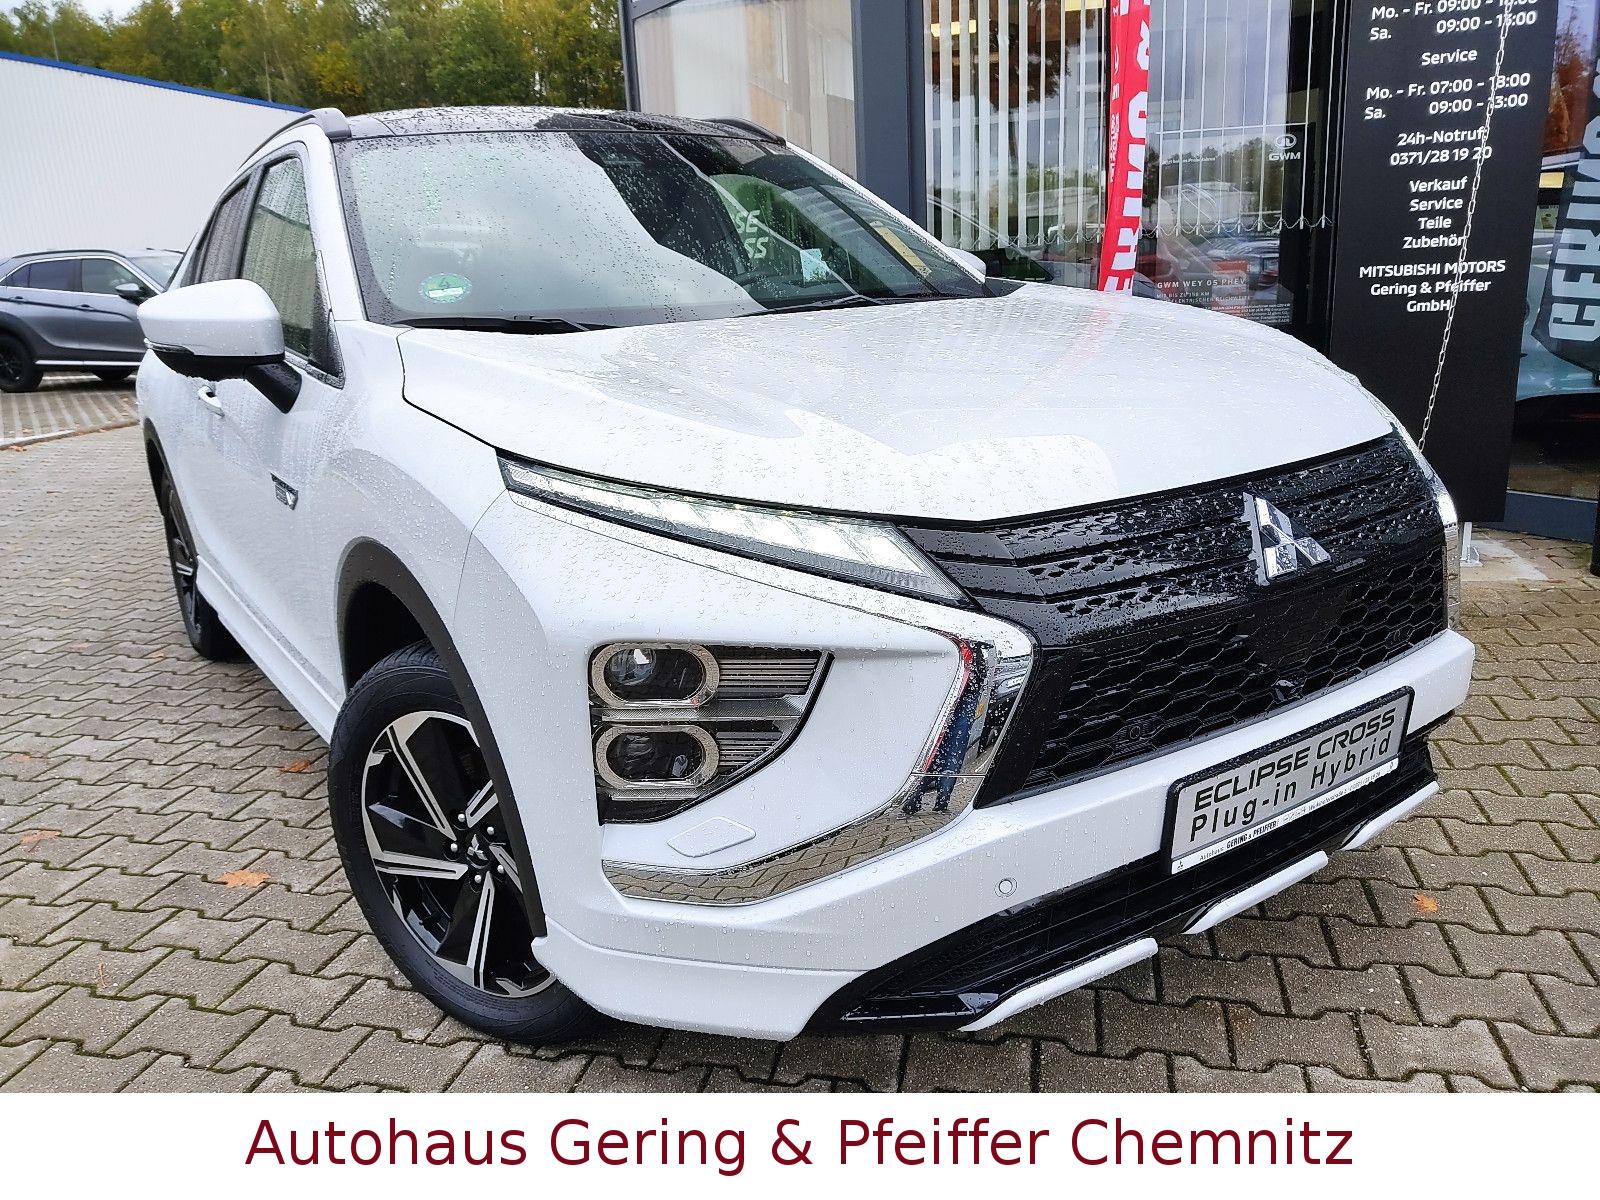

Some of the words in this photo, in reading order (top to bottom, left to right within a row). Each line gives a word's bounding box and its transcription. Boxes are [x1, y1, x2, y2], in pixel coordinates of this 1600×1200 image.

[1371, 6, 1399, 21] Mo.
[1414, 2, 1433, 16] Fr.
[1369, 27, 1392, 41] Sa.
[1435, 16, 1481, 34] 09:00
[1421, 48, 1478, 66] Service
[1365, 86, 1393, 101] Mo.
[1407, 83, 1427, 97] Fr.
[1430, 78, 1473, 95] 07:00
[1363, 106, 1386, 120] Sa.
[1428, 98, 1473, 115] 09:00
[1397, 126, 1486, 147] 24h-Notruf
[1268, 151, 1301, 161] GWM
[1389, 149, 1450, 167] 0371/28
[1453, 147, 1470, 161] 19
[1472, 145, 1493, 160] 20
[1409, 175, 1468, 193] Verkauf
[1409, 197, 1464, 212] Service
[1418, 216, 1452, 230] Teile
[1402, 233, 1465, 250] Zubehör
[1359, 262, 1441, 279] MITSUBISHI
[1444, 259, 1507, 275] MOTORS
[1157, 281, 1179, 289] GWM
[1183, 280, 1203, 288] WEY
[1221, 278, 1247, 286] PHEV
[1370, 282, 1417, 297] Gering
[1420, 281, 1432, 294] &
[1435, 278, 1492, 293] Pfeiffer
[1406, 299, 1452, 313] GmbH
[1193, 746, 1311, 813] ECLIPSE
[1316, 707, 1397, 761] CROSS
[1190, 780, 1298, 843] Plug-in
[1309, 730, 1393, 790] Hybrid
